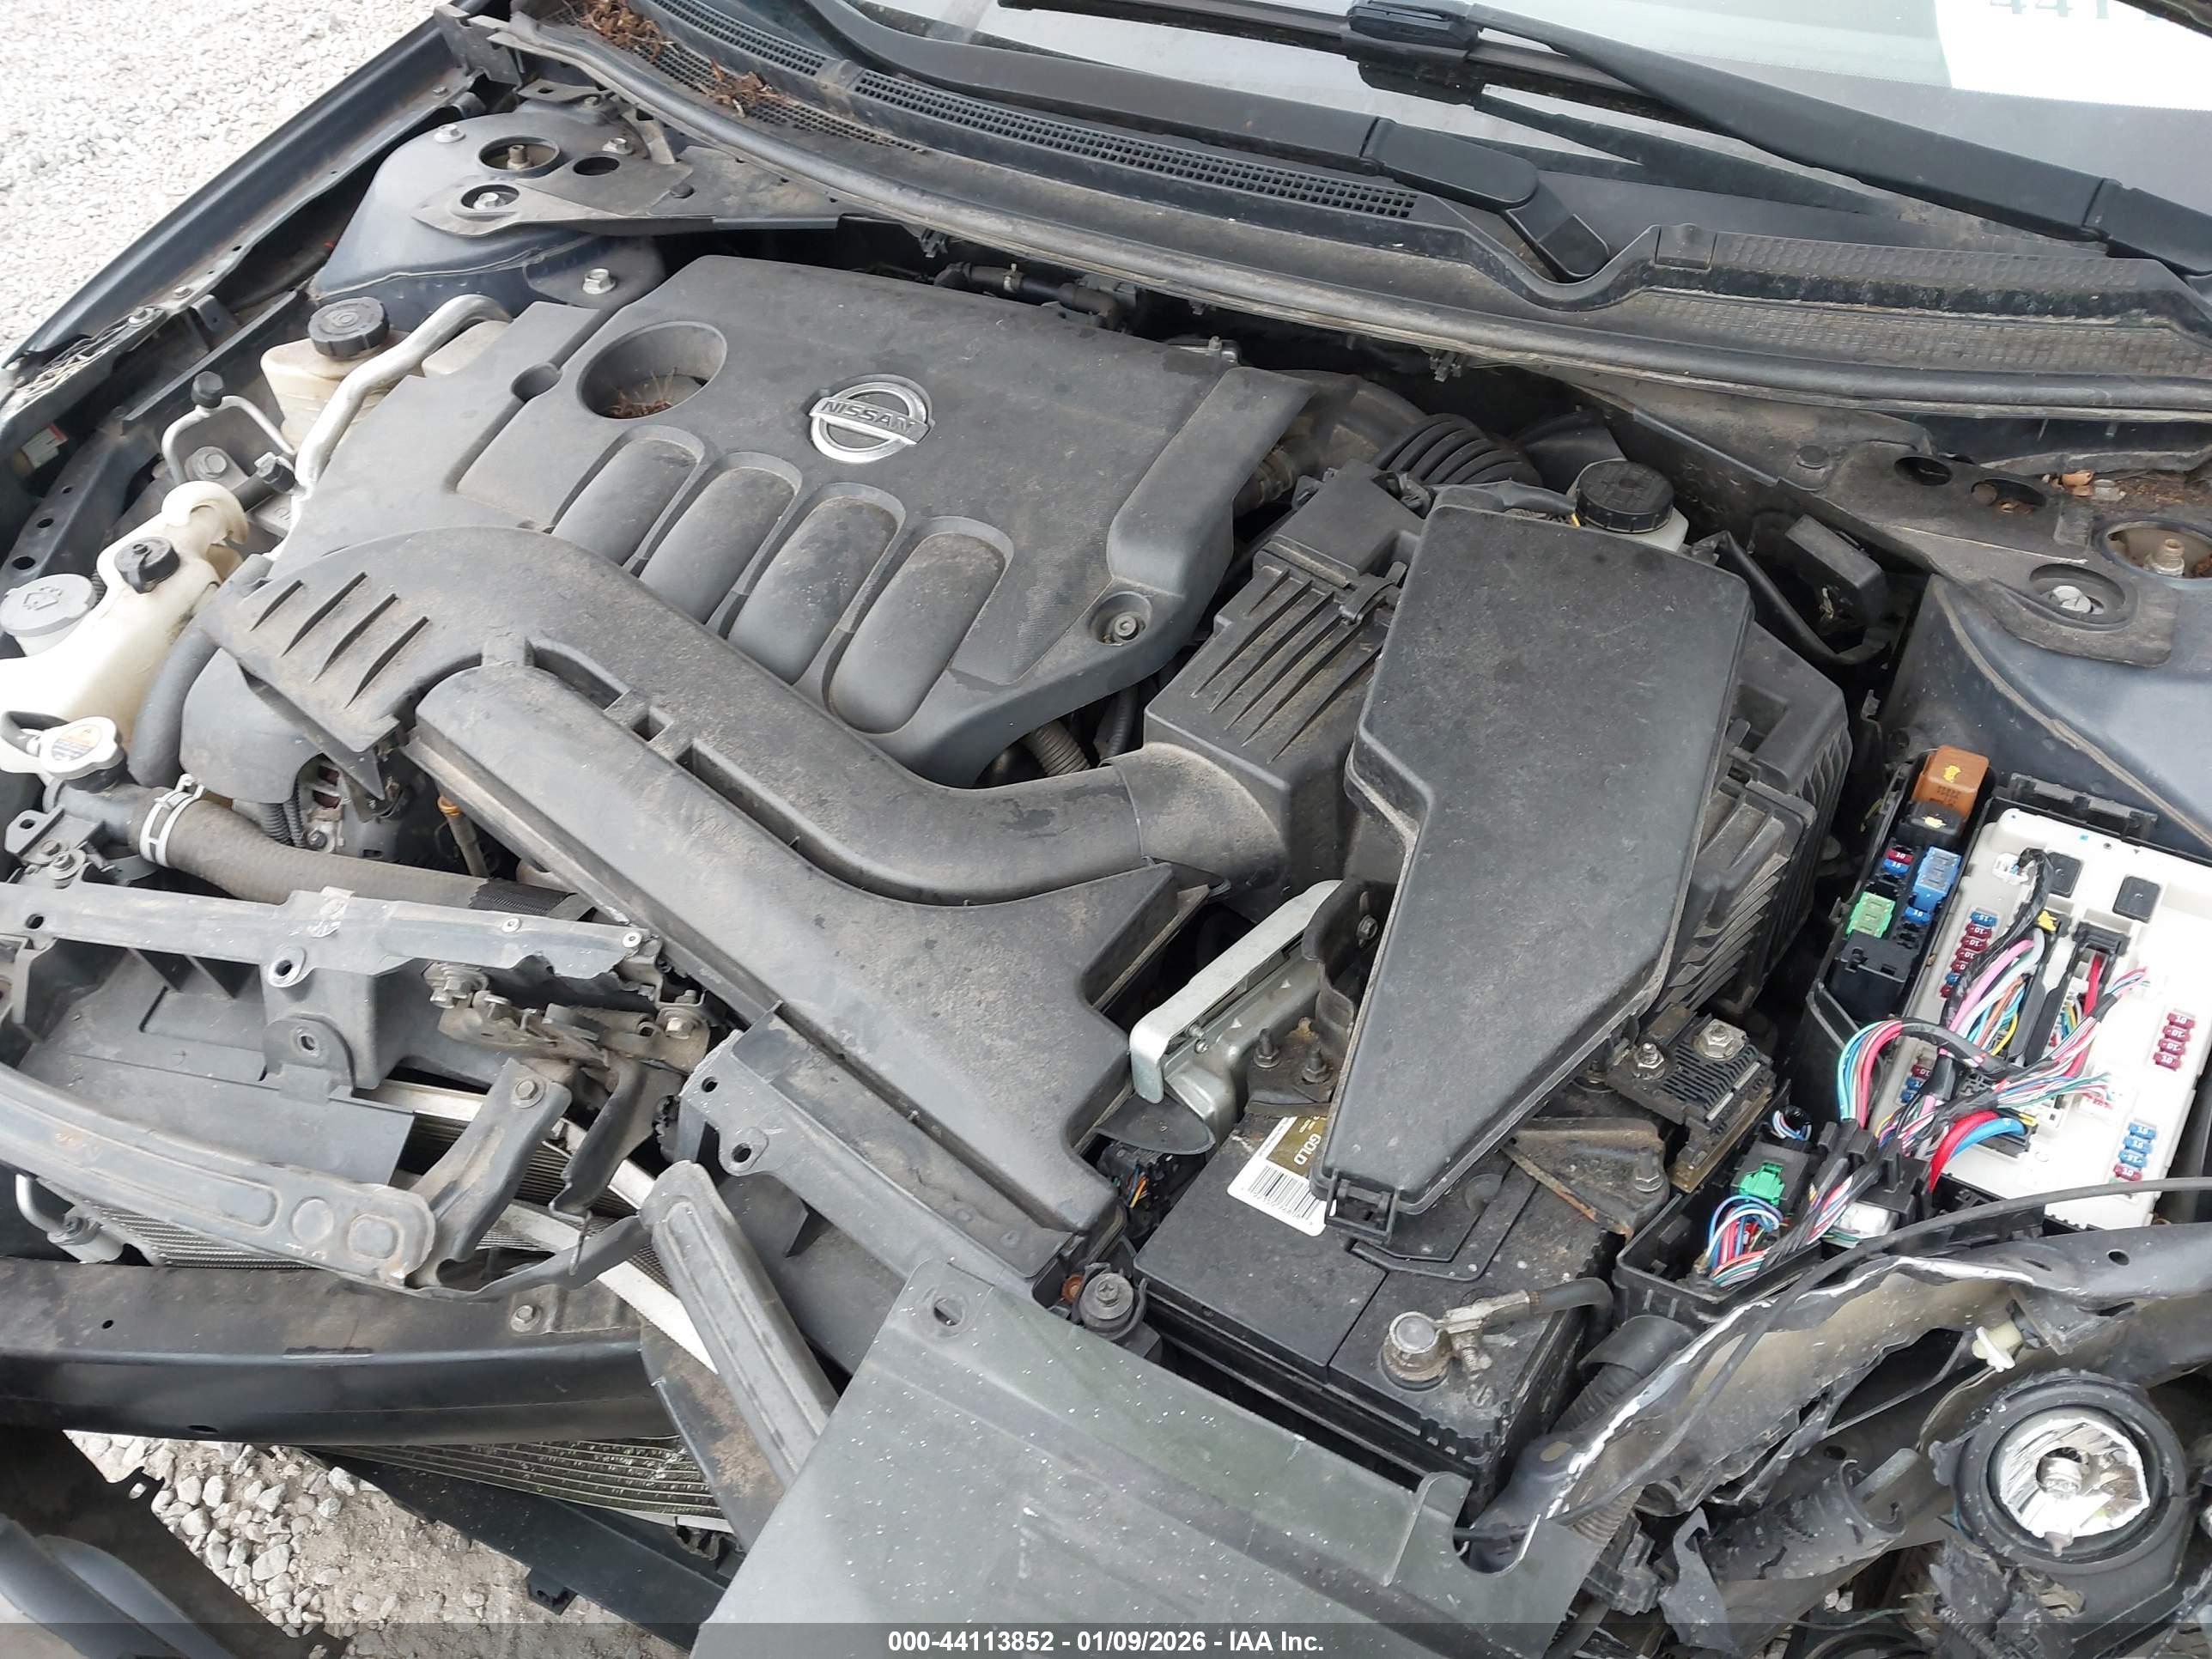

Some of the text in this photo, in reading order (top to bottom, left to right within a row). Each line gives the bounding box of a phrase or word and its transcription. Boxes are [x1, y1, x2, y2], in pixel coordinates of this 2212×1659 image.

[821, 400, 916, 434] NISSAN
[2175, 1016, 2187, 1024] 10
[2161, 1055, 2173, 1064] 10
[1293, 1133, 1322, 1166] GOLD
[2123, 1168, 2135, 1176] 10
